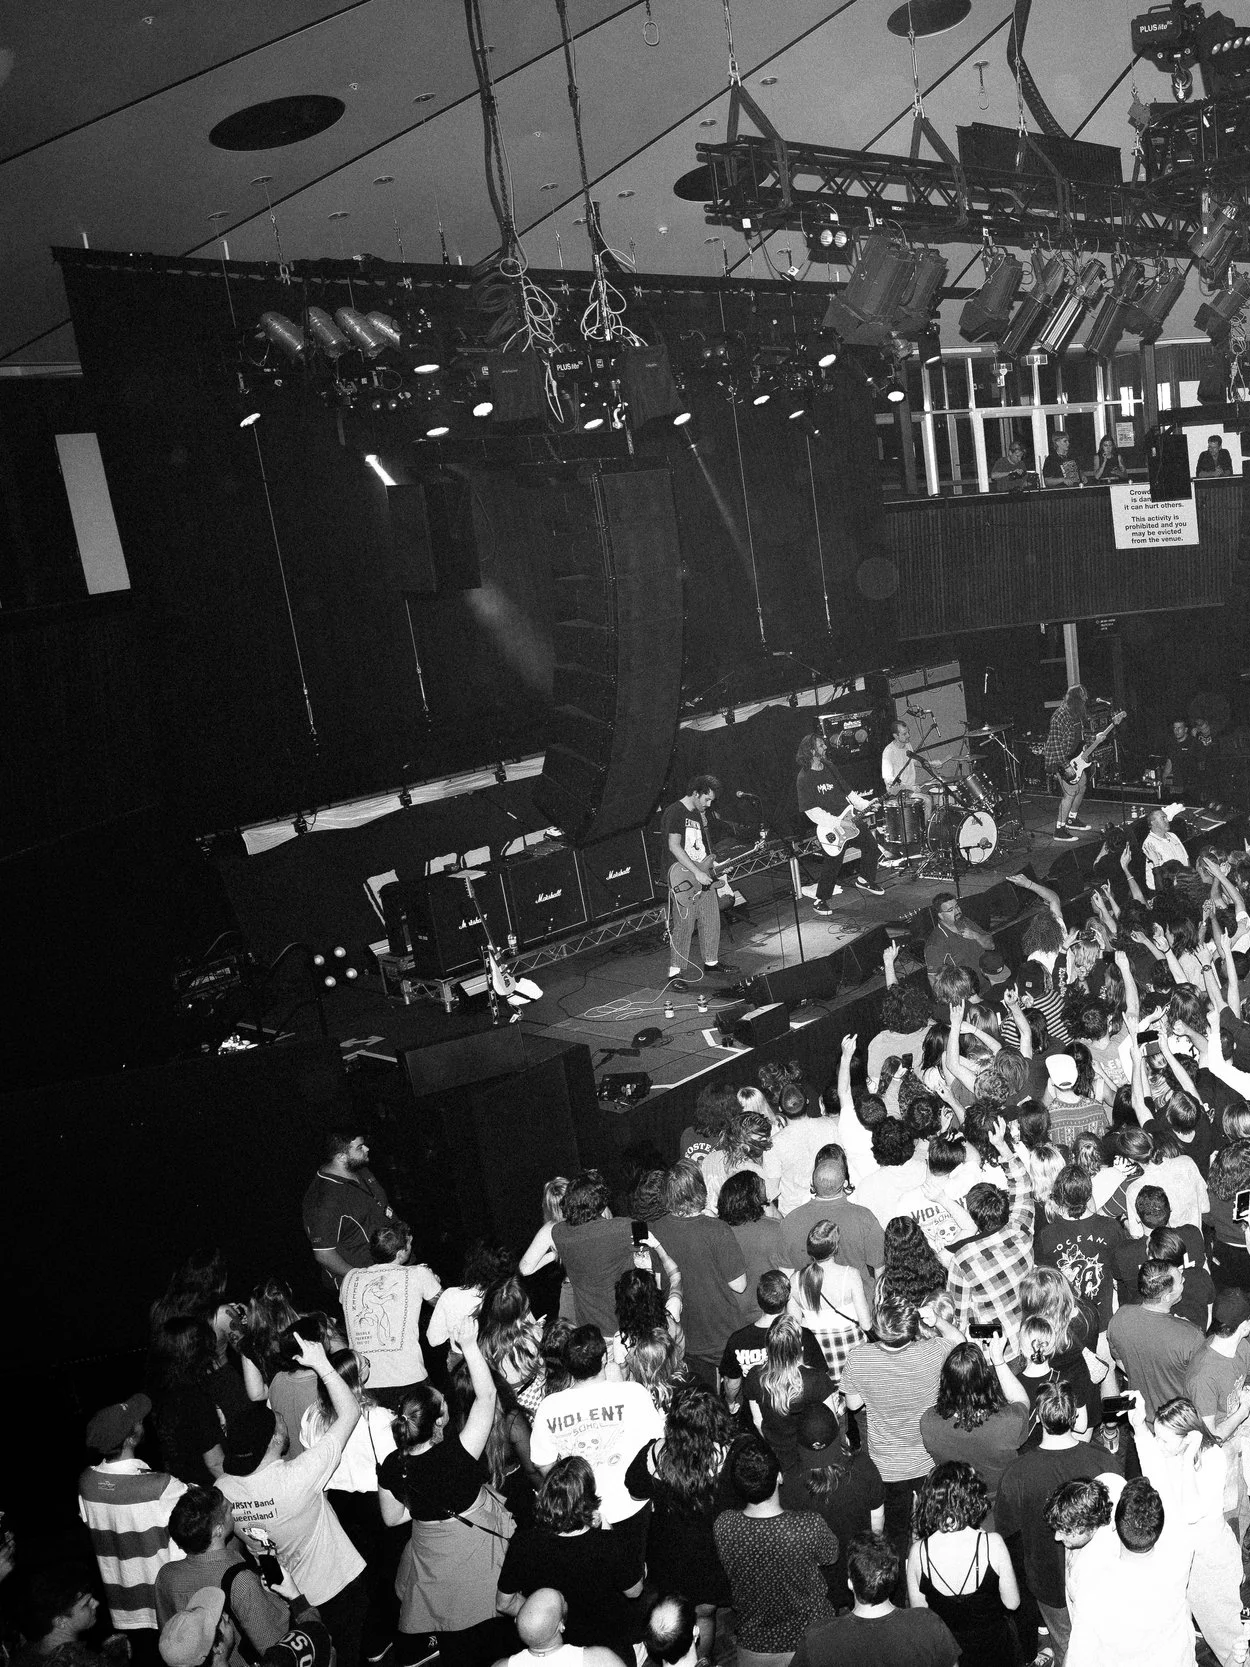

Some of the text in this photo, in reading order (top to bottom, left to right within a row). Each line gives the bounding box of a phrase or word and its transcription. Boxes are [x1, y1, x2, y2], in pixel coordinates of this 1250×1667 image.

[1125, 522, 1159, 531] prohibited
[606, 866, 632, 881] Marshall
[535, 889, 562, 904] Marshall
[546, 1404, 625, 1434] VIOLENT
[232, 1498, 275, 1509] IRSTY Band
